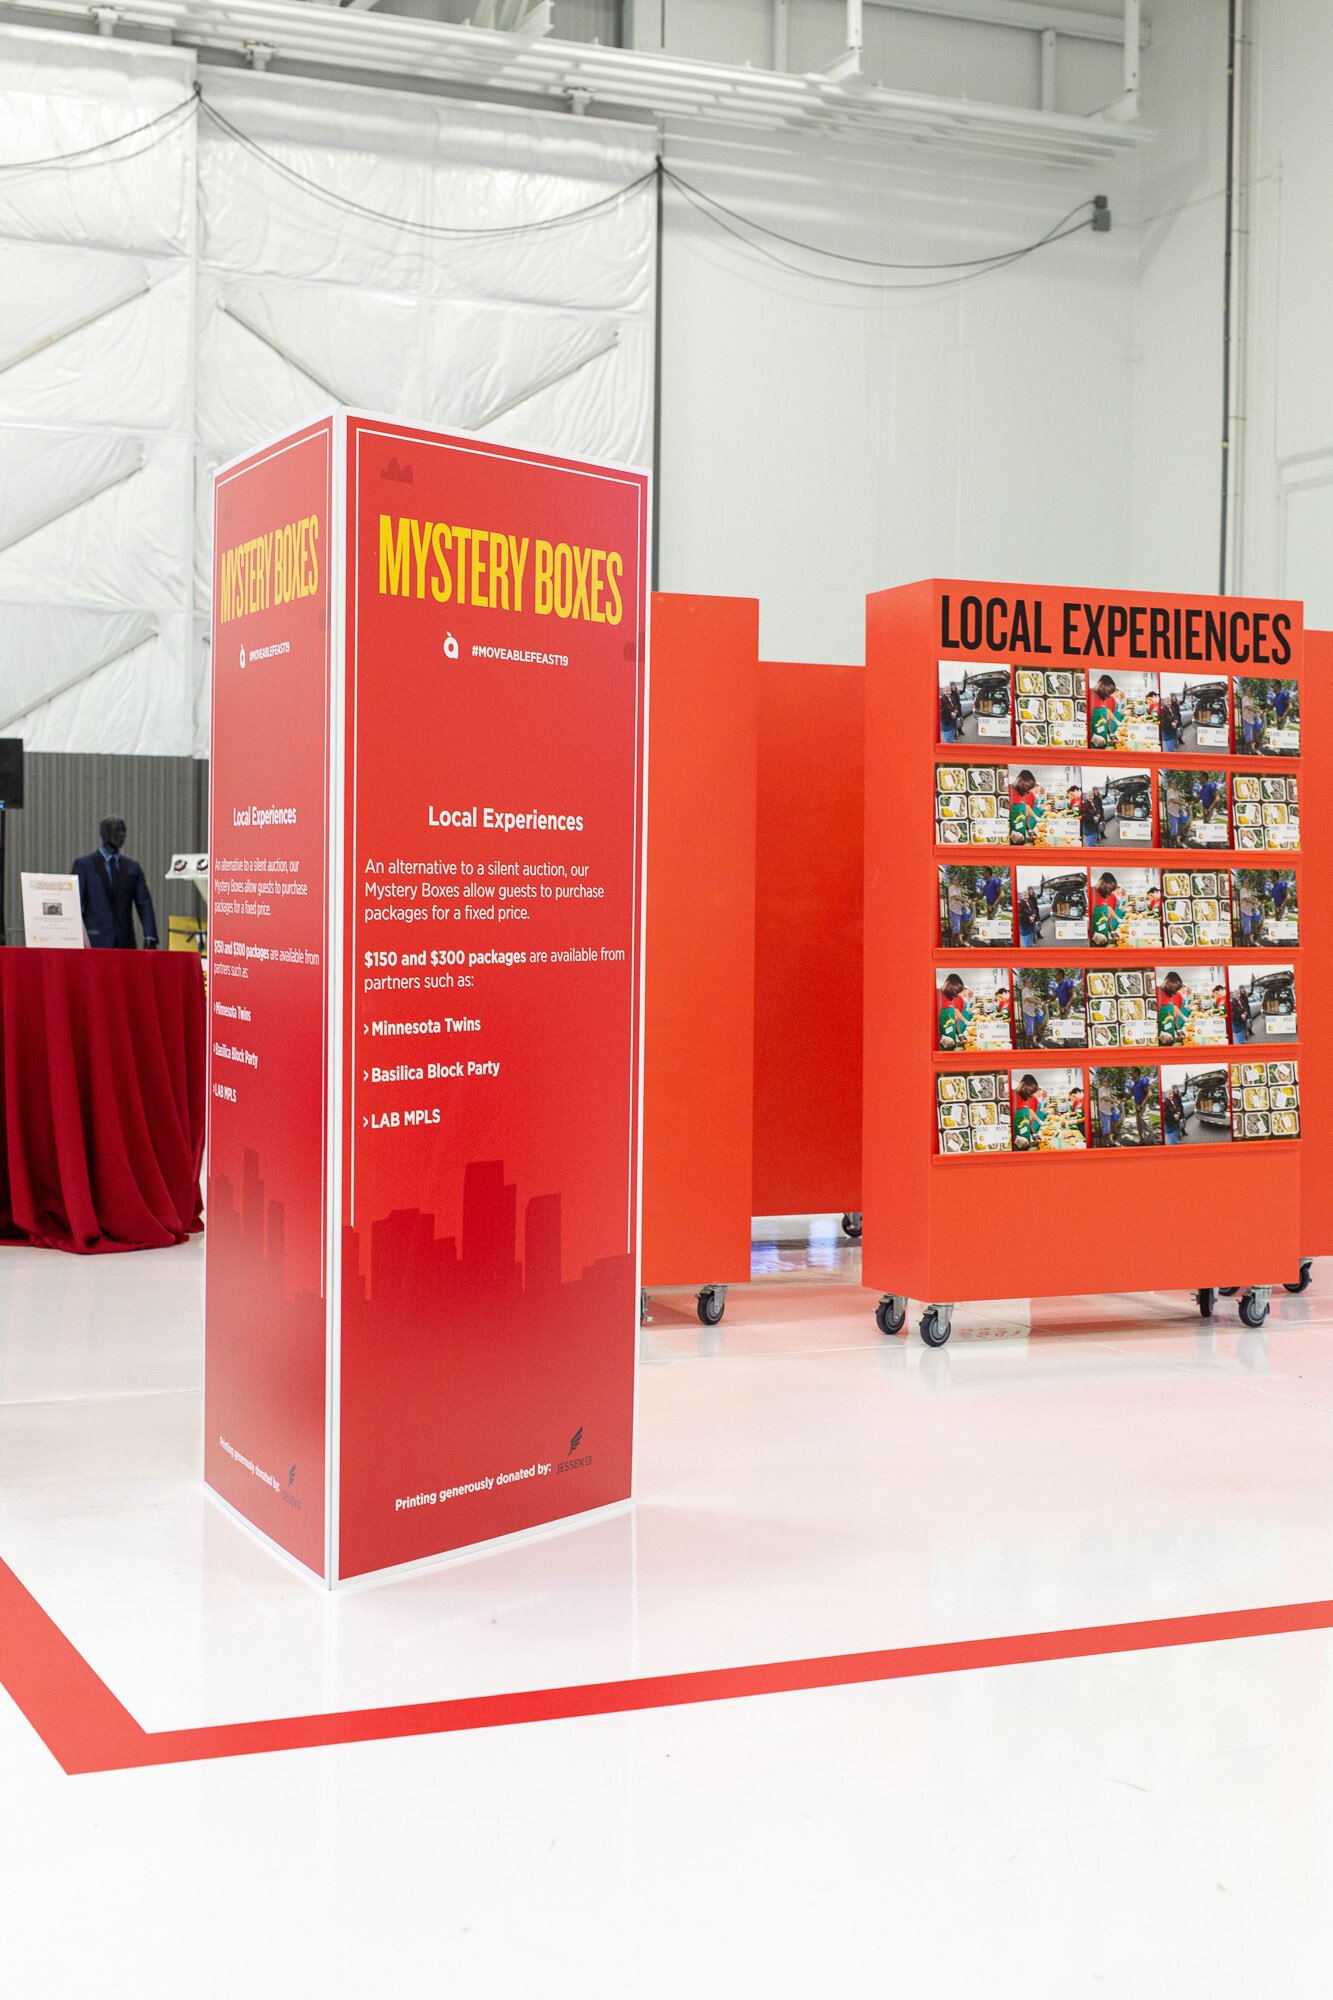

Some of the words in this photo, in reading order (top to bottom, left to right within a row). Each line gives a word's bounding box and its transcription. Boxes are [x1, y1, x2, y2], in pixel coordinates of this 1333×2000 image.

[220, 531, 273, 624] MYSTERY
[274, 514, 318, 606] BOXES
[379, 514, 529, 612] MYSTERY
[534, 539, 623, 626] BOXES
[941, 594, 1052, 654] LOCAL
[1062, 602, 1292, 665] EXPERIENCES
[472, 645, 568, 667] #MOVEABLEFEAST19
[234, 806, 250, 826] Local
[252, 804, 296, 828] Experiences
[428, 806, 477, 828] Local
[483, 808, 584, 832] Experiences
[365, 860, 384, 874] An
[388, 860, 457, 876] alternative
[460, 862, 473, 875] to
[477, 866, 484, 875] a
[488, 860, 519, 876] silent
[522, 862, 568, 878] auction,
[570, 866, 589, 877] our
[282, 880, 308, 896] purchase
[365, 883, 417, 900] Mystery
[422, 883, 459, 897] Boxes
[463, 883, 496, 898] allow
[498, 885, 537, 901] guests
[540, 885, 552, 898] to
[555, 884, 604, 900] purchase
[365, 906, 428, 923] packages
[432, 906, 450, 920] for
[453, 910, 460, 920] a
[464, 905, 494, 920] fixed
[498, 906, 530, 922] price.
[305, 949, 320, 966] from
[364, 951, 397, 967] $150
[402, 951, 426, 966] and
[430, 950, 464, 966] $300
[468, 949, 526, 968] packages
[529, 951, 547, 963] are
[550, 947, 598, 962] available
[600, 947, 625, 961] from
[364, 975, 420, 993] partners
[424, 973, 453, 988] such
[457, 976, 474, 987] as:
[372, 1020, 440, 1036] Minnesota
[444, 1018, 481, 1033] Twins
[371, 1065, 423, 1083] Basilica
[427, 1062, 464, 1079] Block
[467, 1060, 500, 1077] Party
[371, 1112, 400, 1129] LAB
[404, 1108, 440, 1126] MPLS
[395, 1492, 437, 1512] Printing
[439, 1476, 494, 1503] generously
[496, 1466, 535, 1486] donated
[537, 1462, 552, 1477] by:
